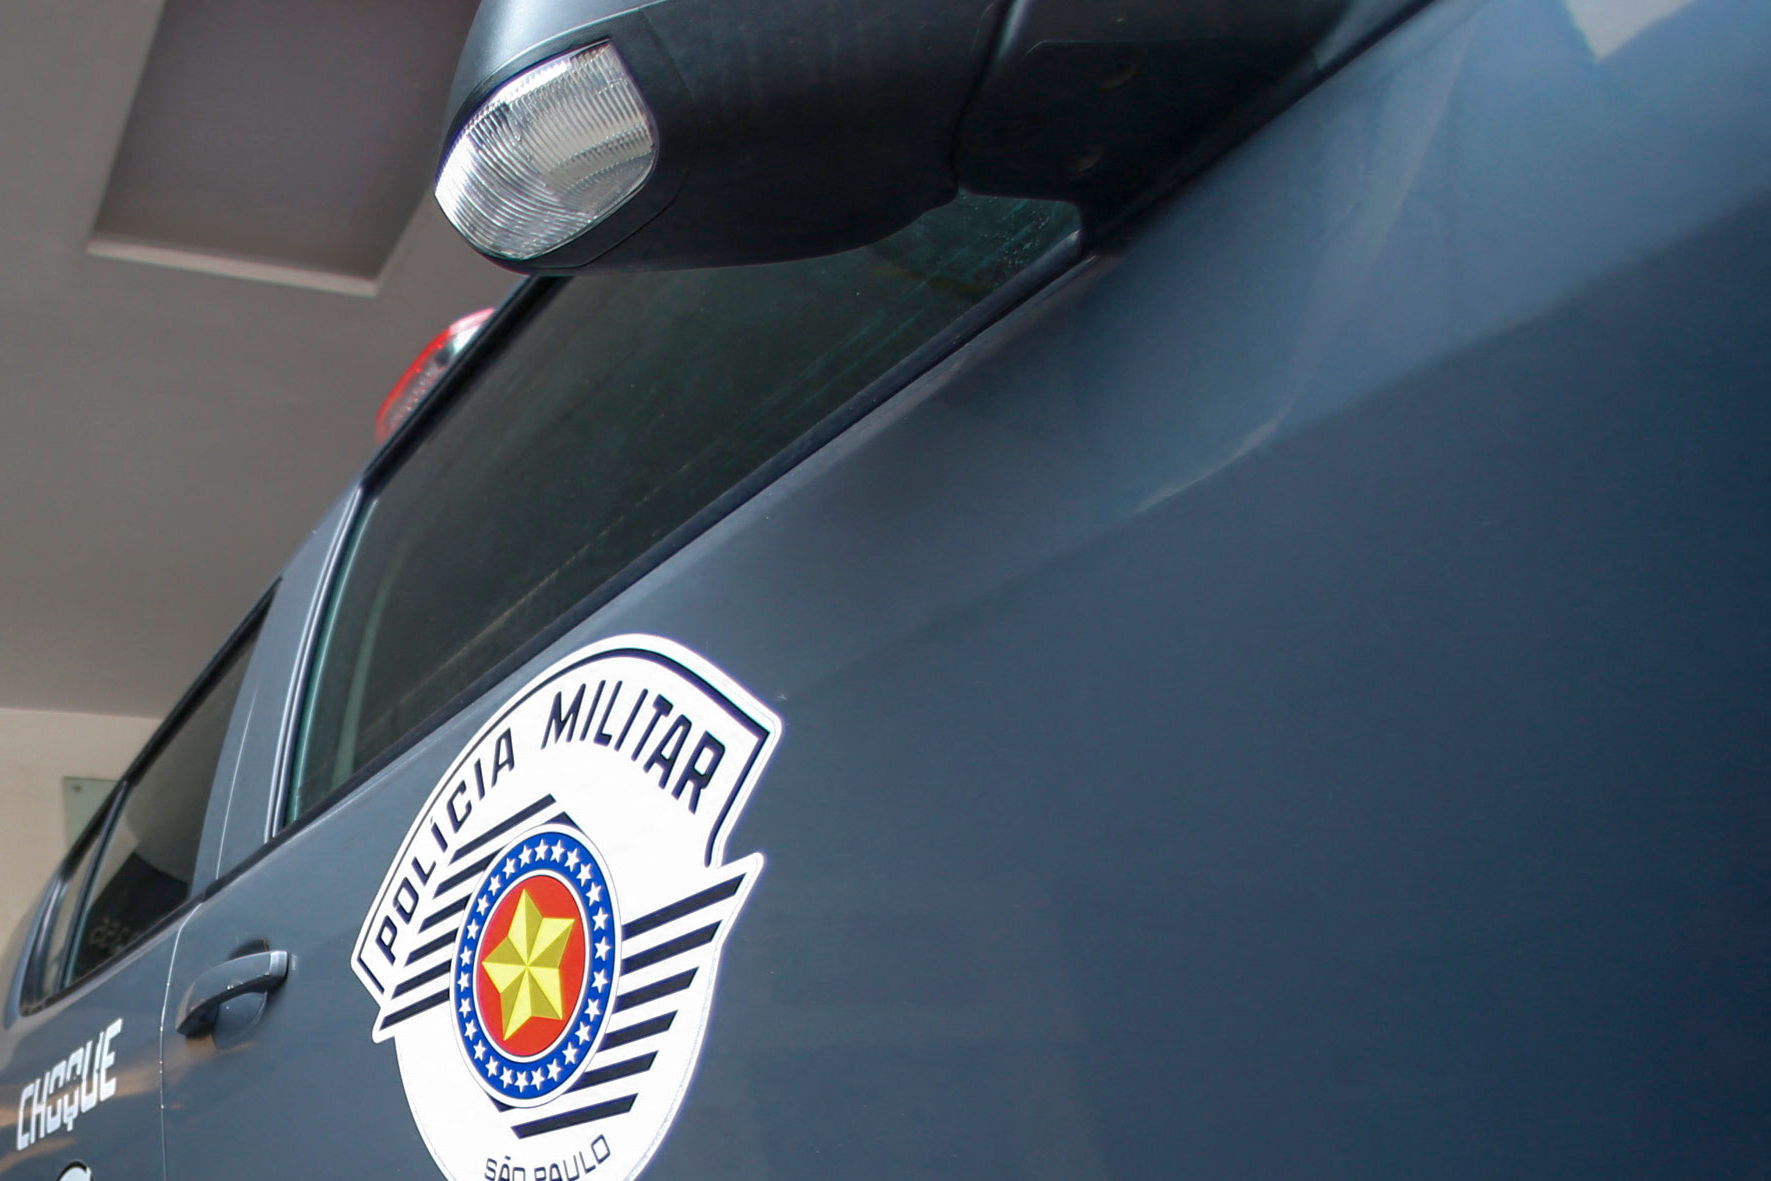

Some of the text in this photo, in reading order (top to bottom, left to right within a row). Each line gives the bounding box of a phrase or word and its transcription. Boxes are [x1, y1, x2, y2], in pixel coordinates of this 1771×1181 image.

[374, 680, 727, 966] POLÍCIA MILITAR
[16, 1017, 123, 1152] CHOQUE
